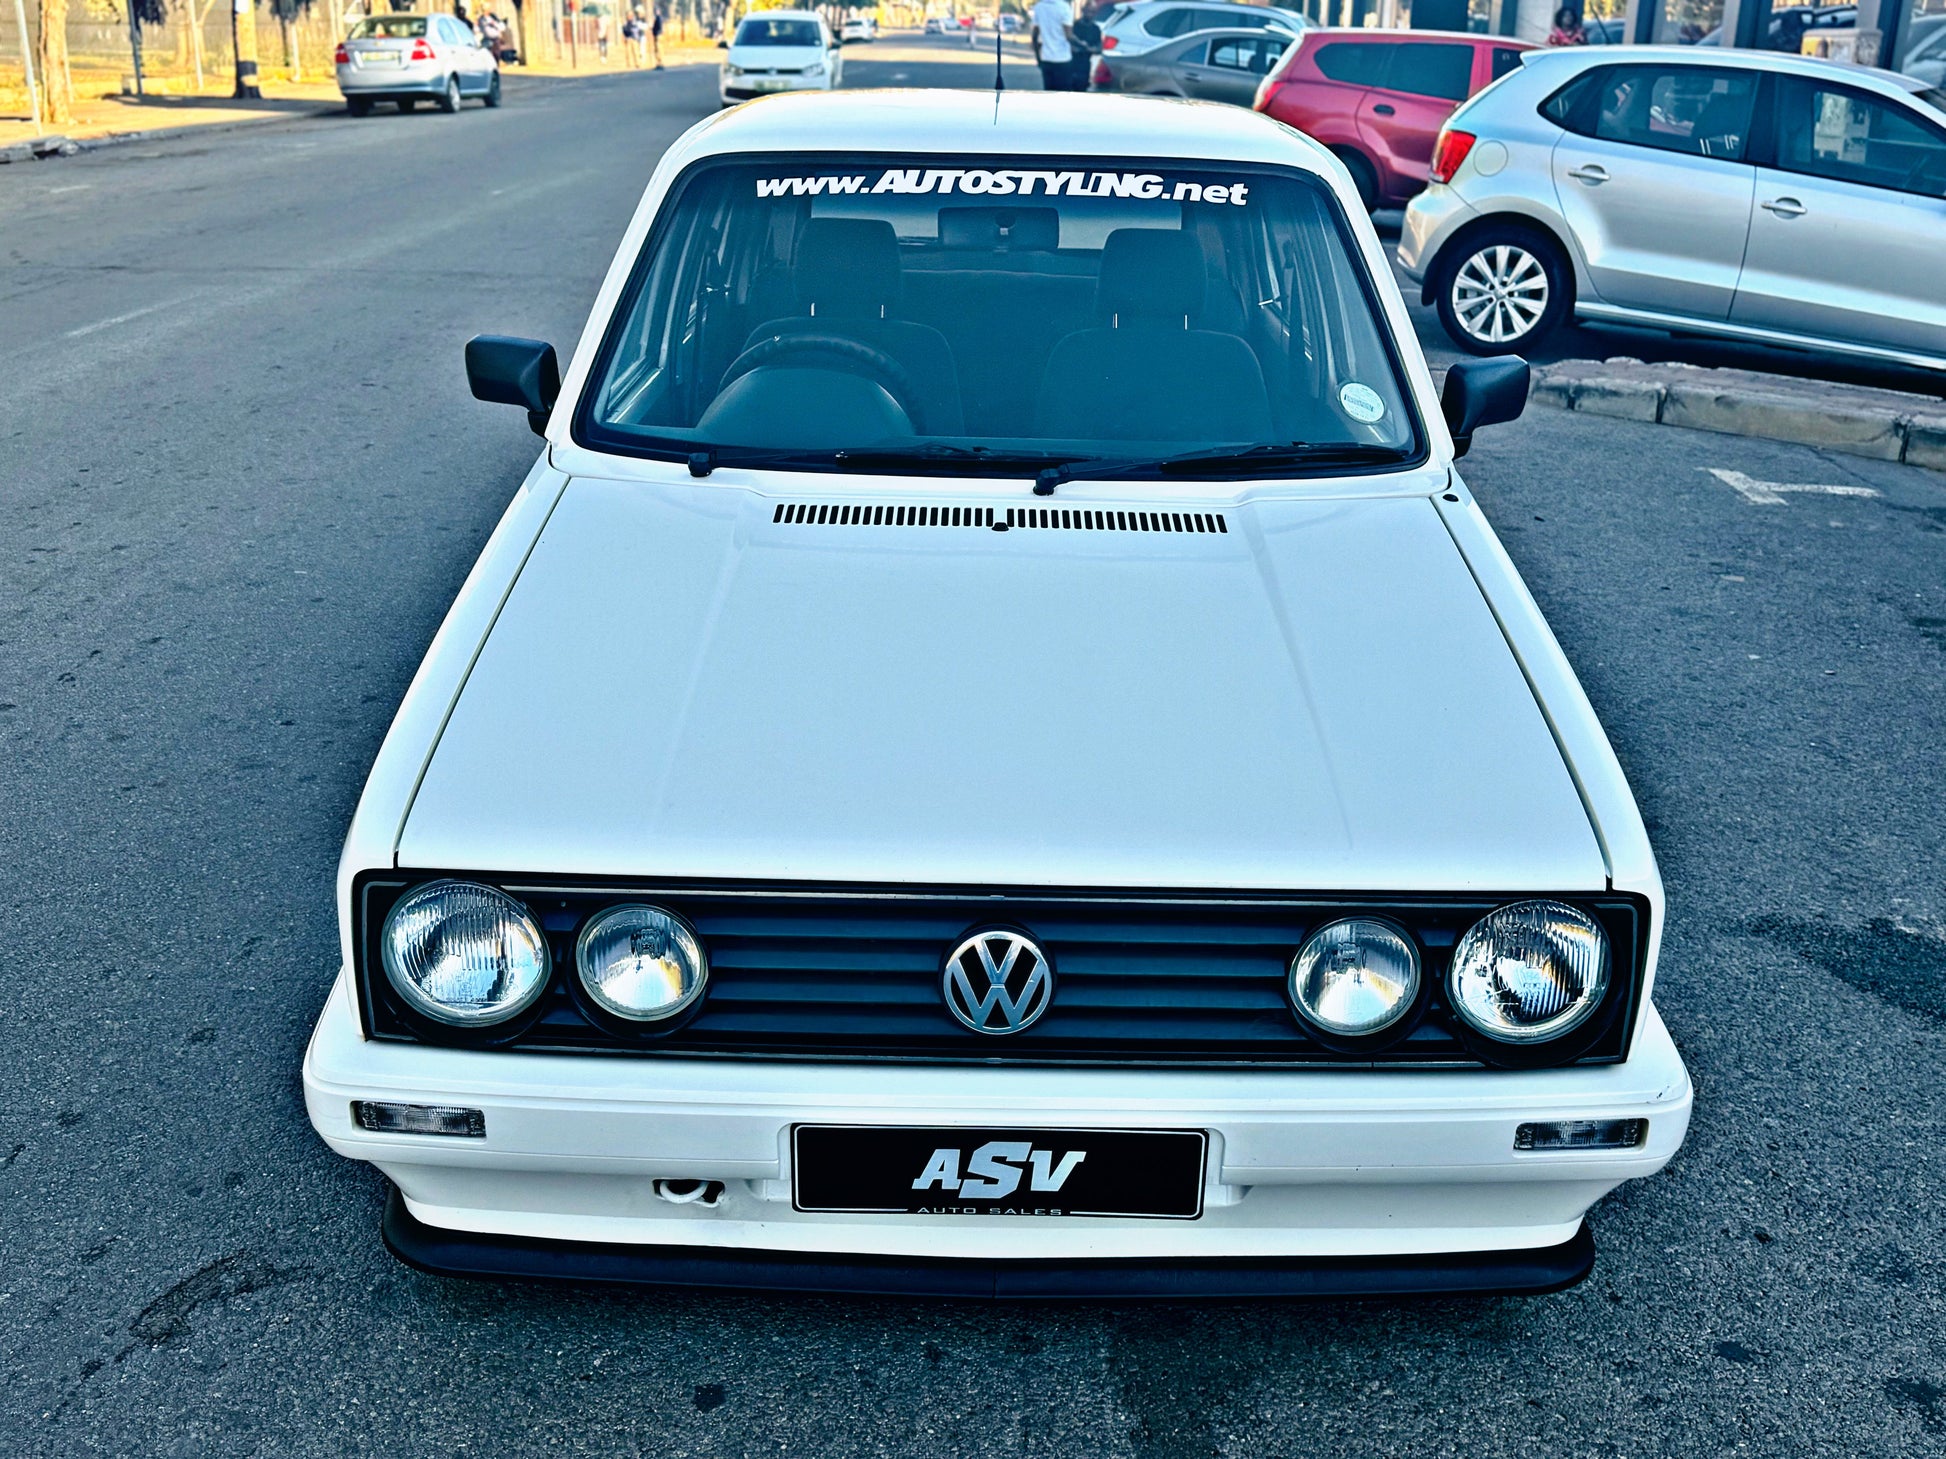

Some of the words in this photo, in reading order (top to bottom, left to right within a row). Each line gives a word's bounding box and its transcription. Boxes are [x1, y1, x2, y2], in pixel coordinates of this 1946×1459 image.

[756, 169, 1249, 206] www.AUTOSTYLING.net
[911, 1141, 1087, 1199] ASV
[917, 1206, 977, 1215] AUTO
[989, 1207, 1062, 1216] SALES
